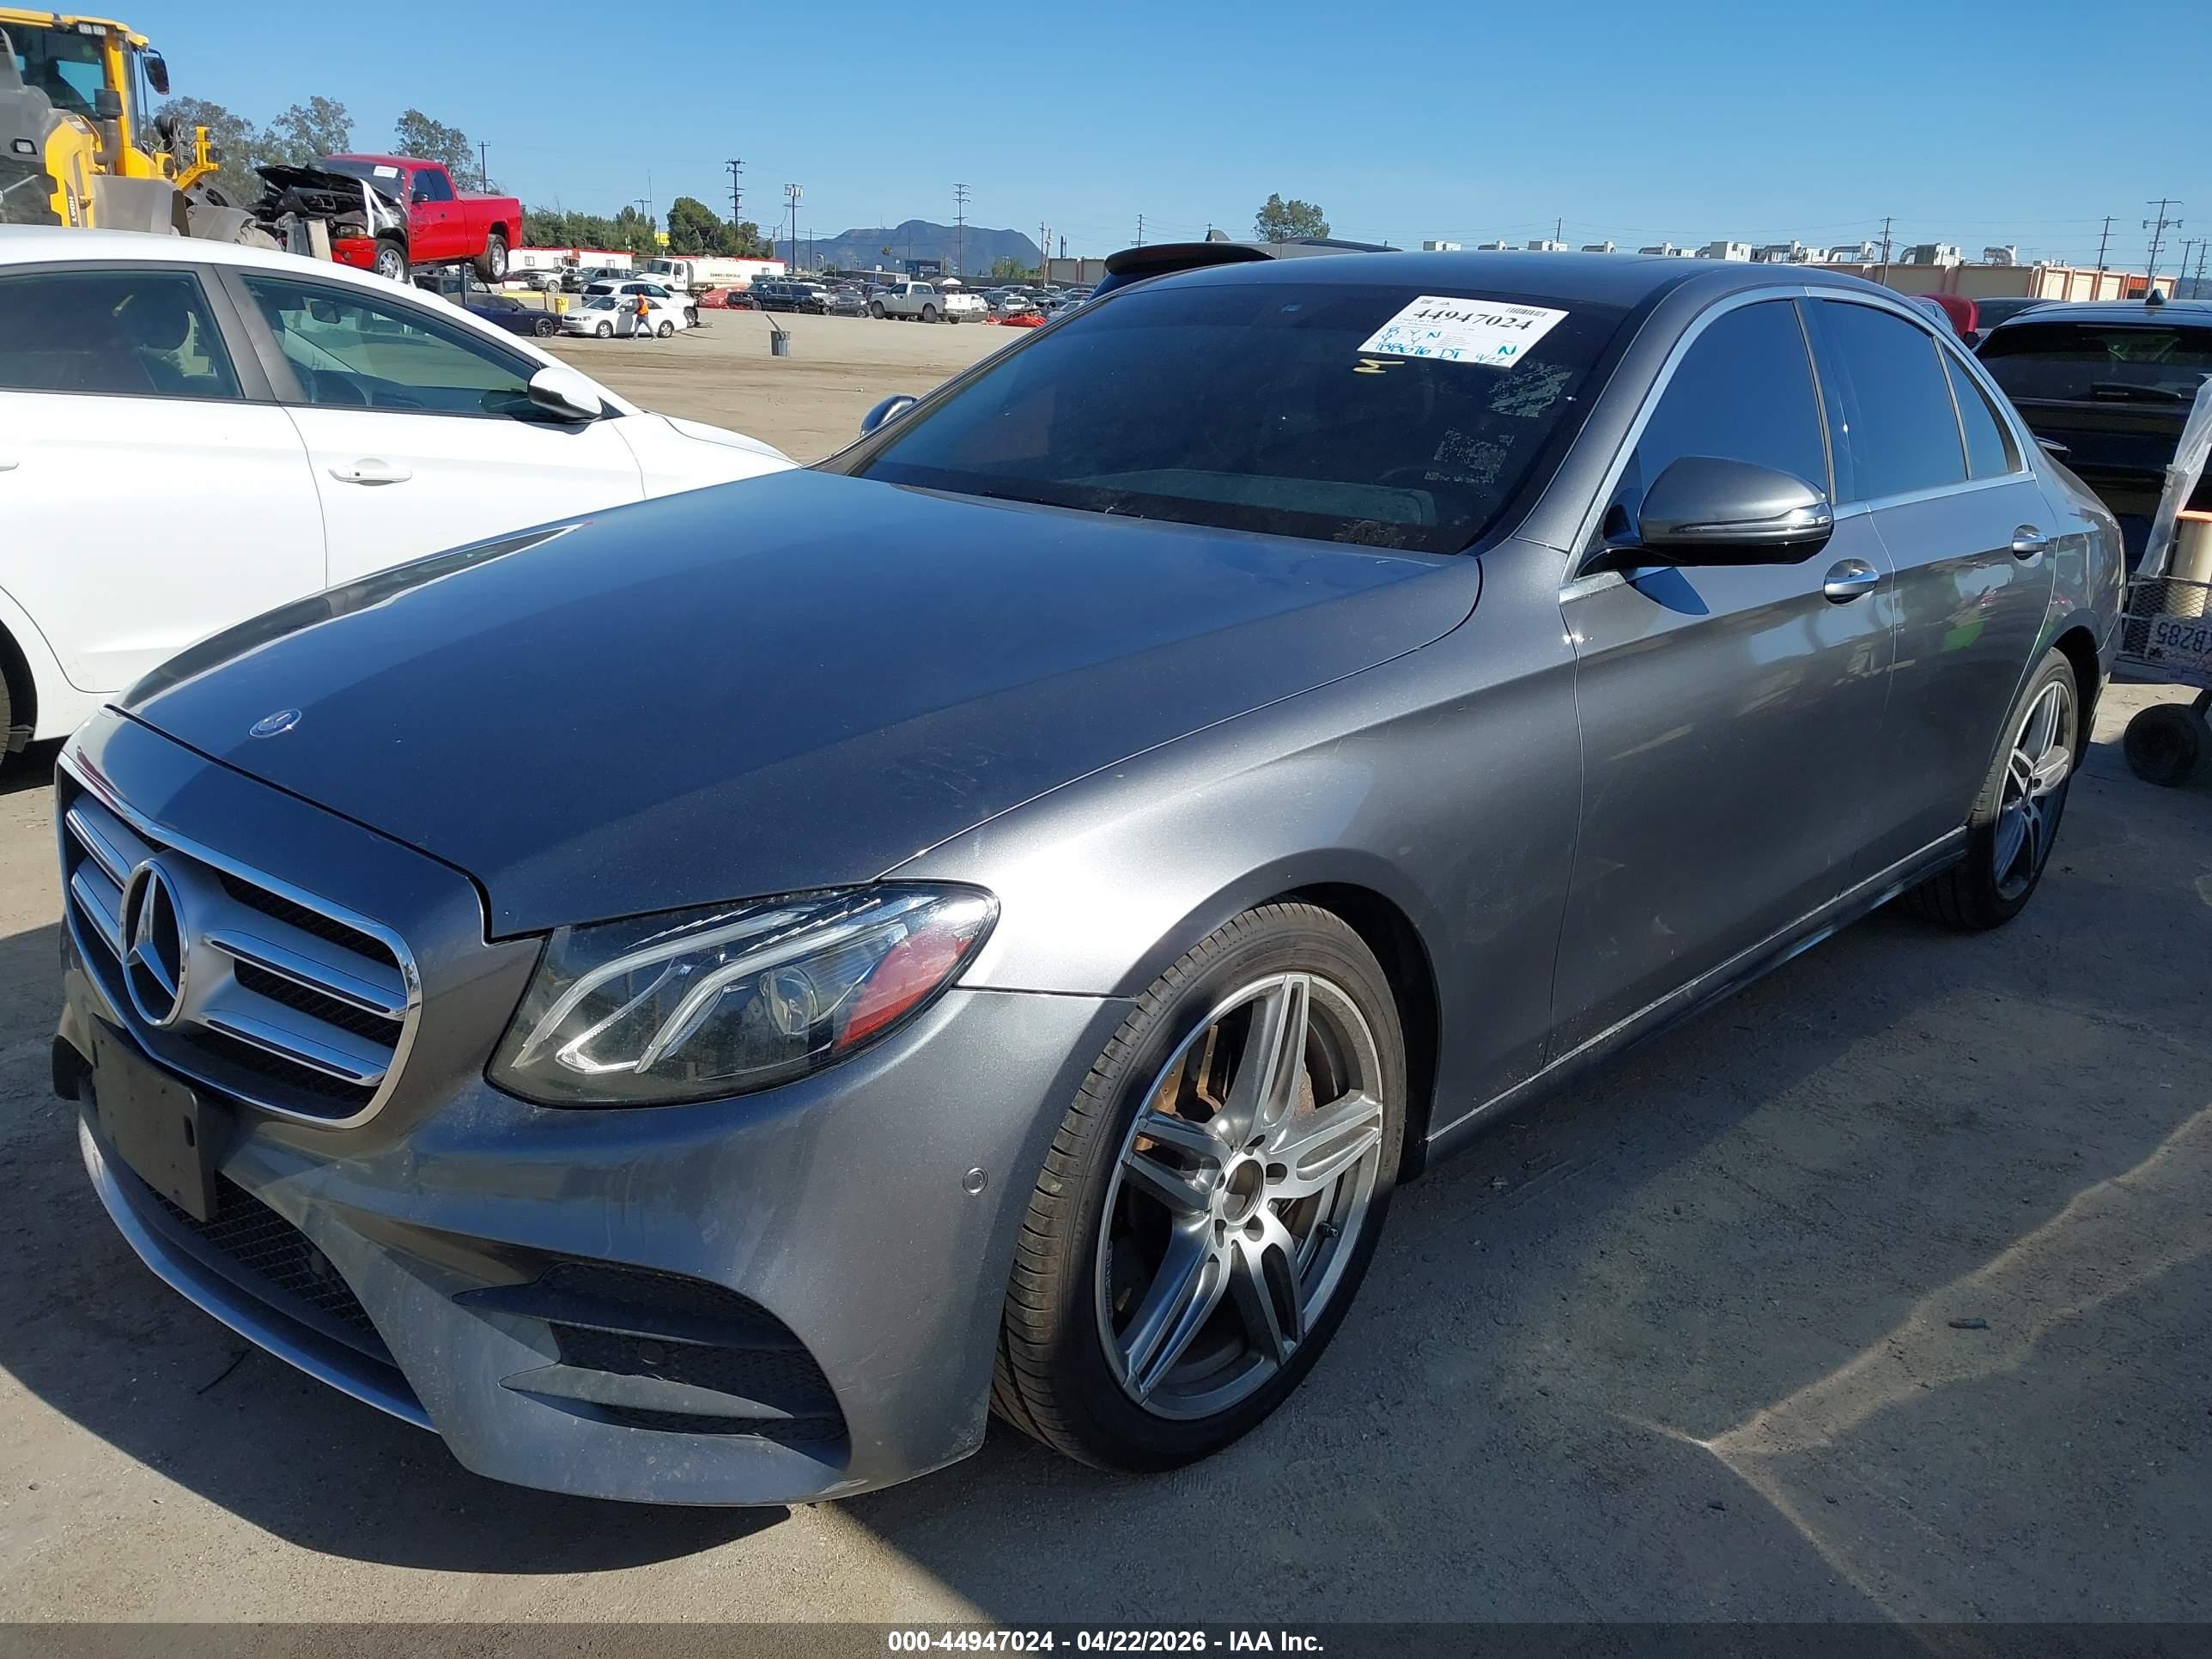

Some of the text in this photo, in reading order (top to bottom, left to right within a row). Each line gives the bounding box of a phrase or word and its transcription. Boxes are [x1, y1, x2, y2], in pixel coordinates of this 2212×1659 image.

[1413, 308, 1534, 331] 44947024
[1426, 331, 1442, 339] N
[1497, 344, 1518, 356] N
